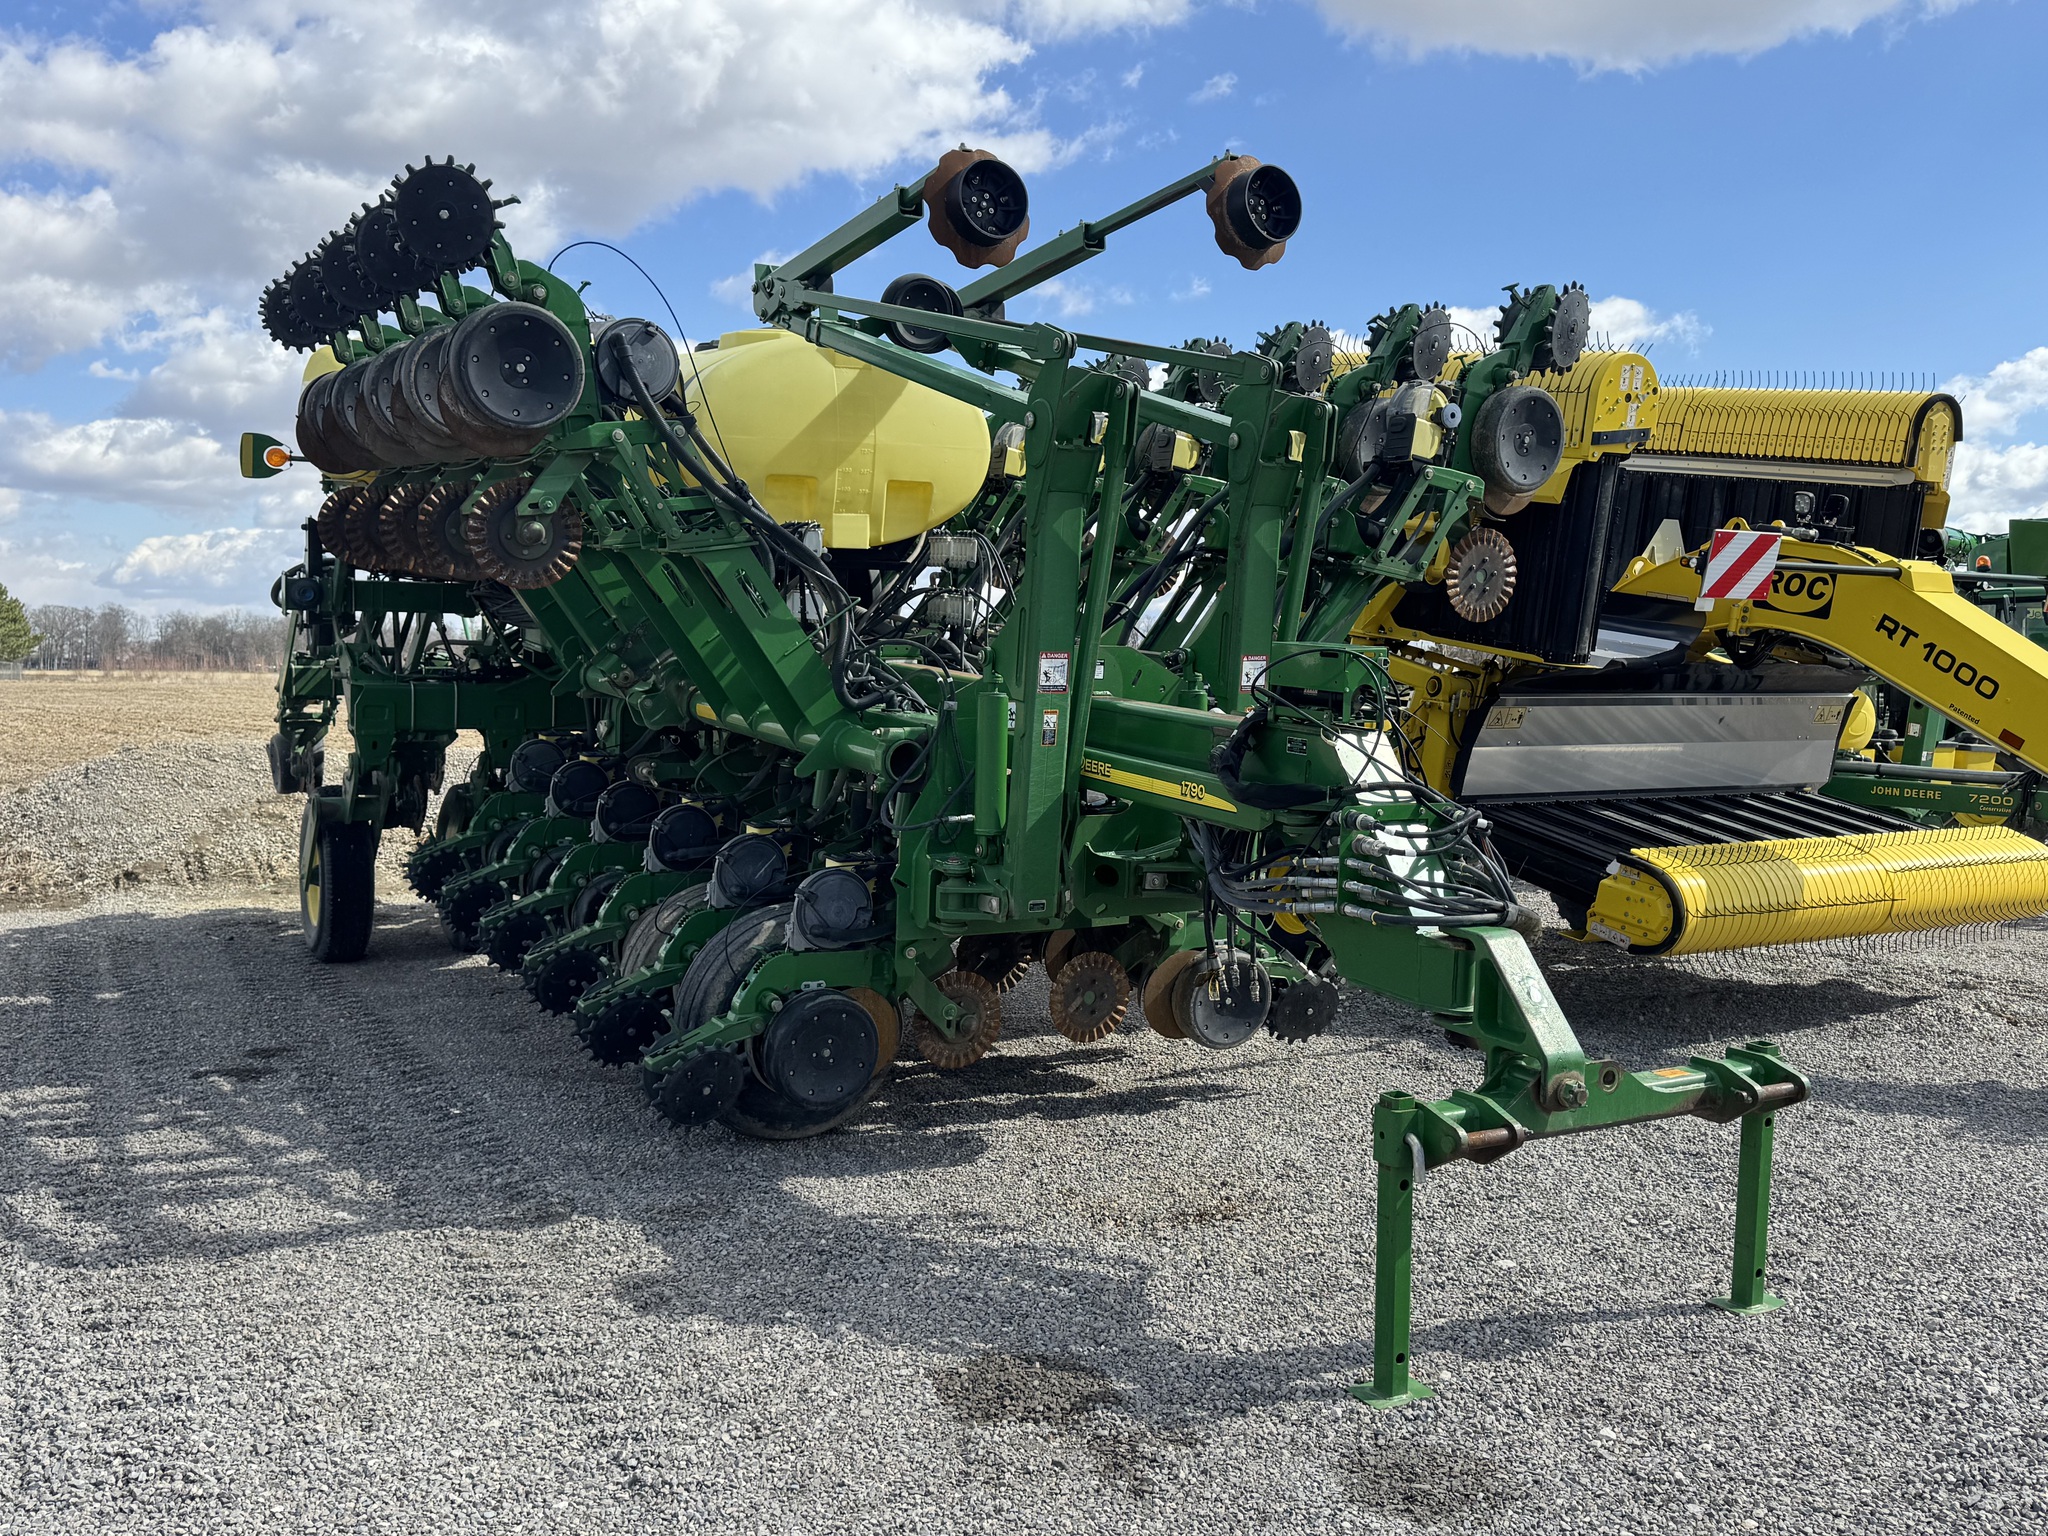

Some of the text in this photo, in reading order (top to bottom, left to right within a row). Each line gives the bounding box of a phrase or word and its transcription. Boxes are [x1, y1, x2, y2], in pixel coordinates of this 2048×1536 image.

[1875, 613, 2000, 700] RT 1000
[1948, 703, 1981, 725] Patented
[1180, 780, 1206, 799] 1790
[1870, 785, 1942, 800] JOHN DEERE
[1968, 793, 2014, 806] 7200
